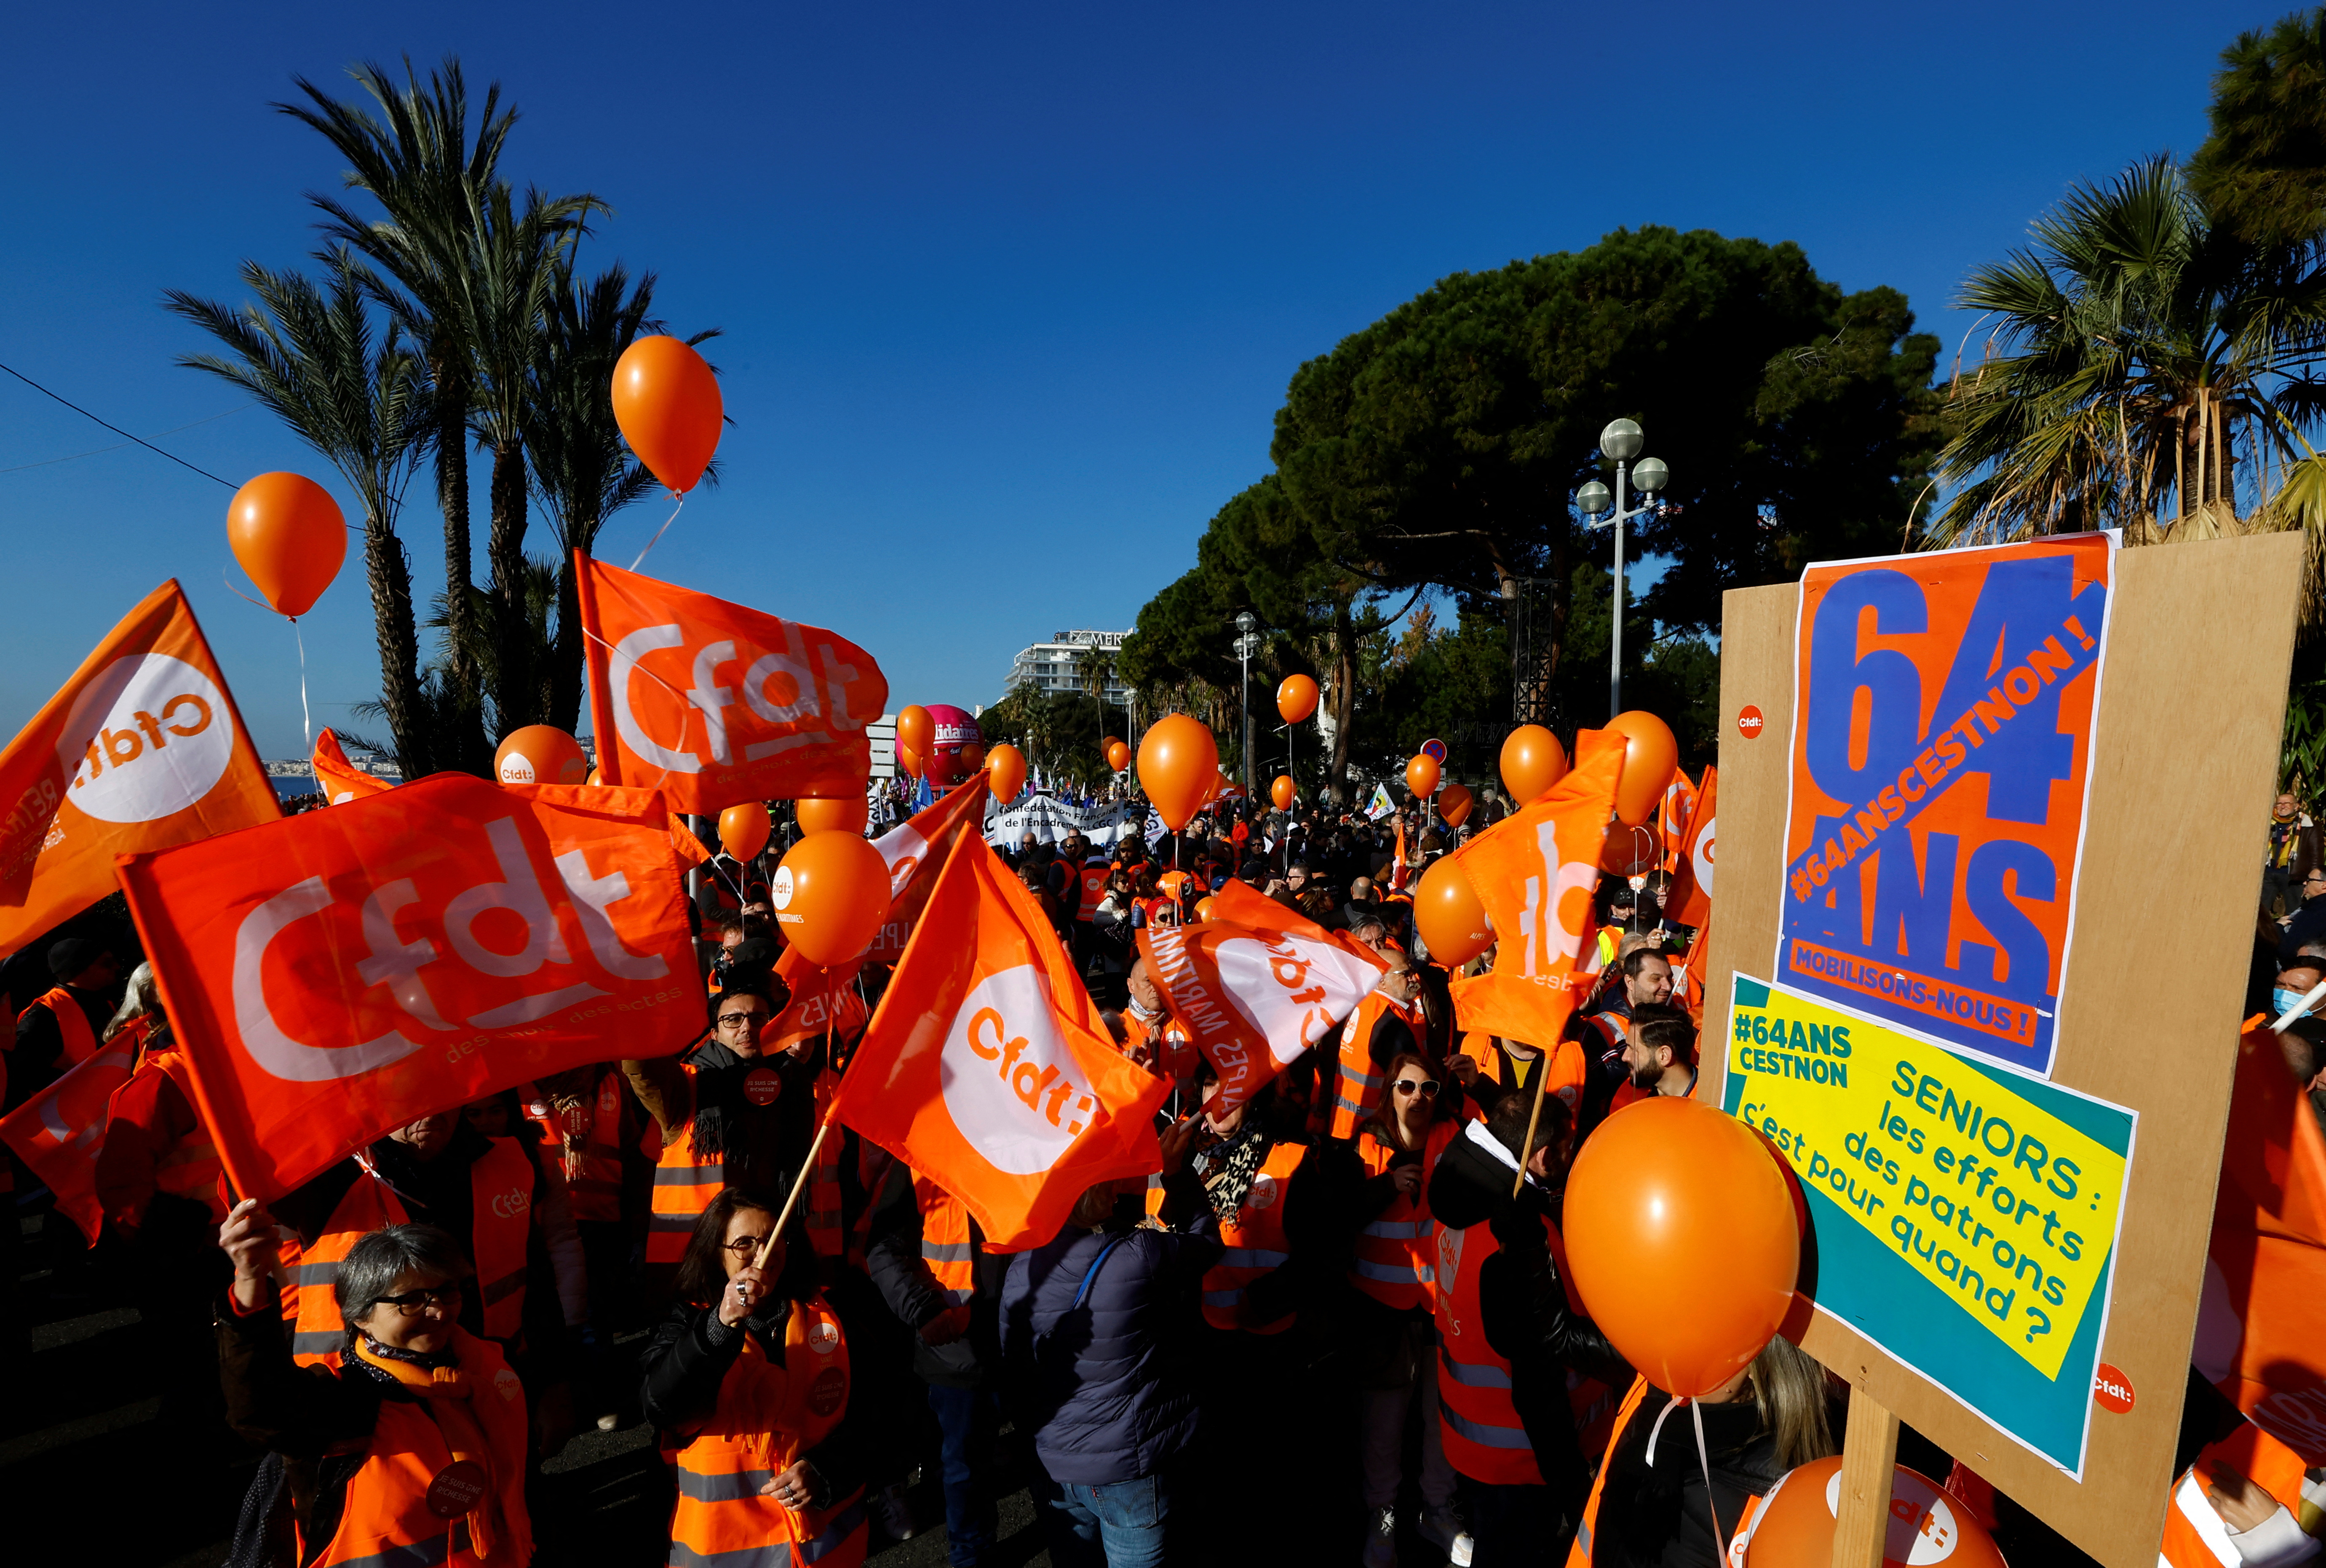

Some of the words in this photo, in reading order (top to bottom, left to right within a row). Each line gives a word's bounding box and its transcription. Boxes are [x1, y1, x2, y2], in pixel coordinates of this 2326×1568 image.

[1806, 555, 2074, 825] 64
[935, 724, 979, 740] lidaires
[1739, 717, 1762, 727] Cfdt:
[503, 769, 532, 780] Cfdt:
[1790, 634, 2075, 903] #64ANSCESTNON
[999, 803, 1071, 817] Confédération
[1074, 806, 1118, 821] Française
[1005, 818, 1019, 827] de
[1021, 817, 1090, 831] l'Encadrement
[1092, 819, 1113, 830] CGC
[232, 815, 671, 1081] Cfdt
[1795, 946, 2012, 1032] MOBILISONS-NOUS
[445, 1034, 490, 1064] des
[569, 1004, 611, 1023] des
[617, 986, 684, 1011] actes
[1735, 1013, 1852, 1058] #64ANS
[967, 1007, 1093, 1136] Cfdt:
[1739, 1047, 1848, 1089] CESTNON
[1891, 1060, 2081, 1200] SENIORS
[1248, 1186, 1275, 1199] Cfdt:
[1878, 1101, 1926, 1155] les
[1933, 1146, 2084, 1261] efforts
[1743, 1102, 1807, 1163] c'est
[1807, 1150, 1885, 1217] pour
[1890, 1215, 2015, 1322] quand
[1844, 1131, 1900, 1186] des
[1904, 1173, 2067, 1307] patrons
[811, 1333, 837, 1345] Cfdt:
[2095, 1377, 2131, 1403] Cfdt:
[448, 1478, 466, 1489] SUIS
[1890, 1499, 1948, 1548] dt:
